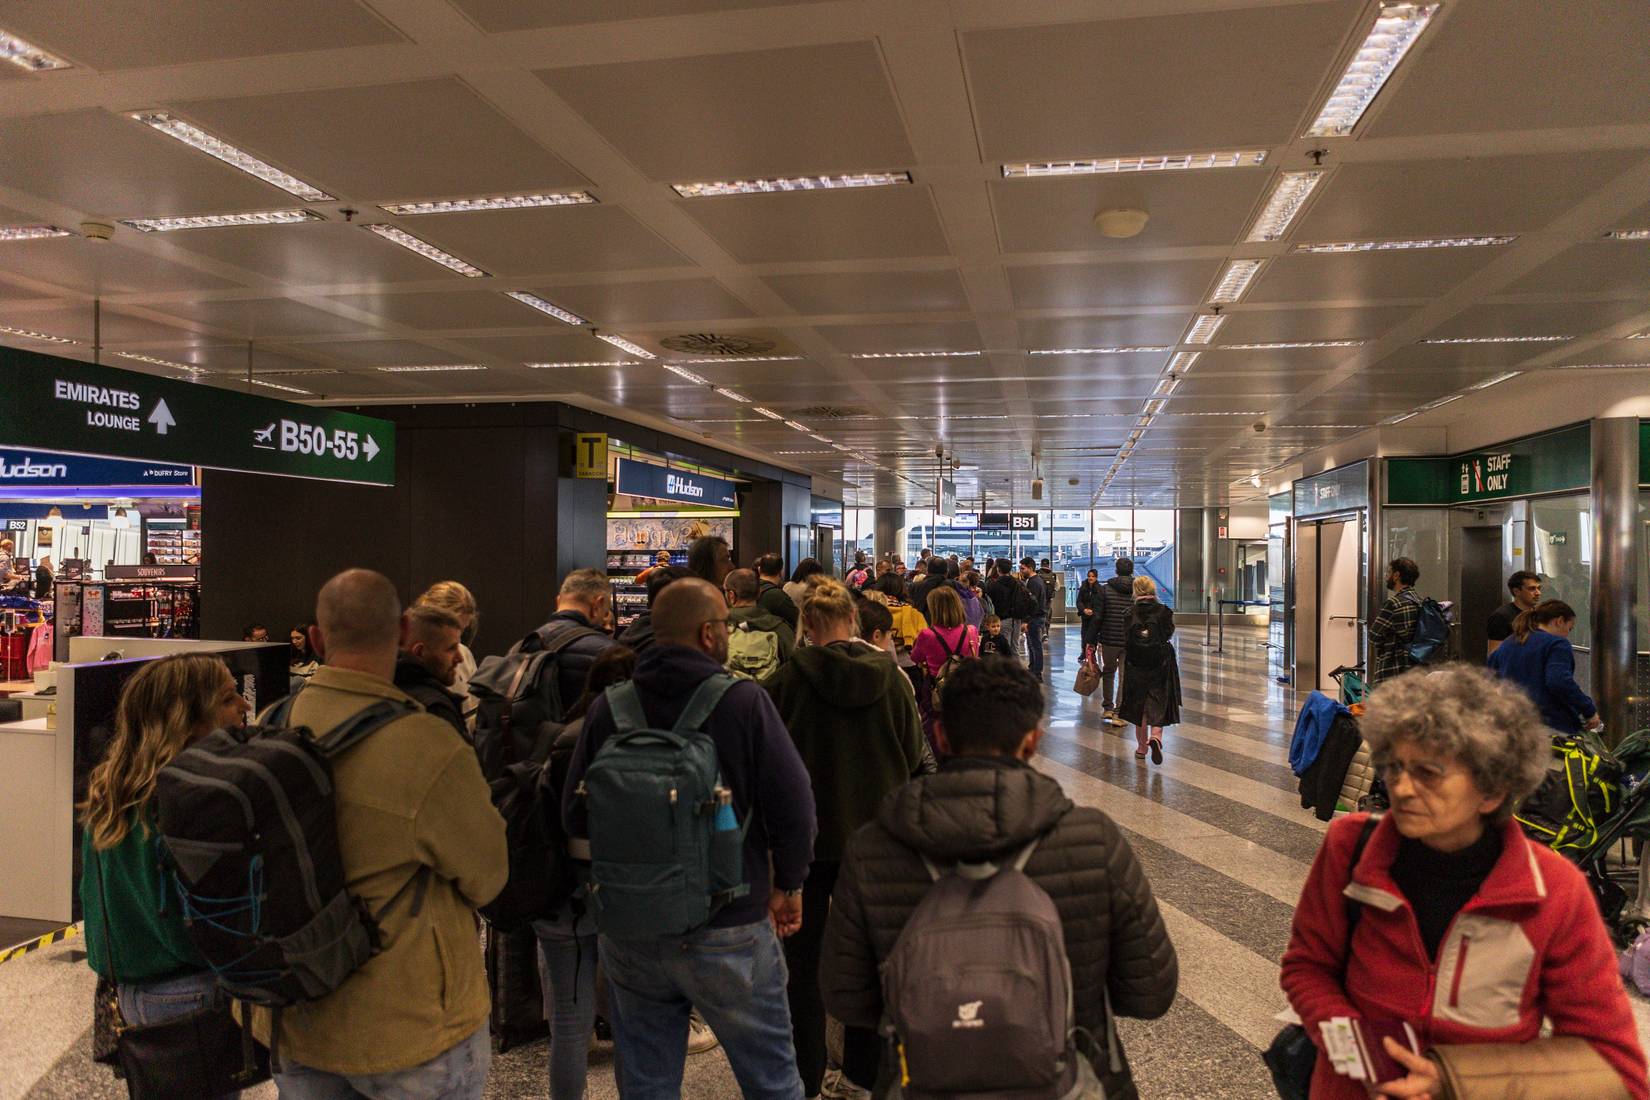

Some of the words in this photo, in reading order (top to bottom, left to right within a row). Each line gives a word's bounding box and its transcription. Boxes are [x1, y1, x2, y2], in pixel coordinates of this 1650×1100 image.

[55, 379, 140, 410] EMIRATES
[87, 410, 140, 431] LOUNGE
[281, 418, 359, 461] B50-55
[582, 437, 601, 468] T
[1487, 453, 1512, 472] STAFF
[675, 477, 703, 497] Hudson
[1487, 473, 1508, 491] ONLY
[10, 520, 26, 530] B52
[1013, 516, 1035, 528] B51
[137, 567, 165, 577] SOUVENIRS
